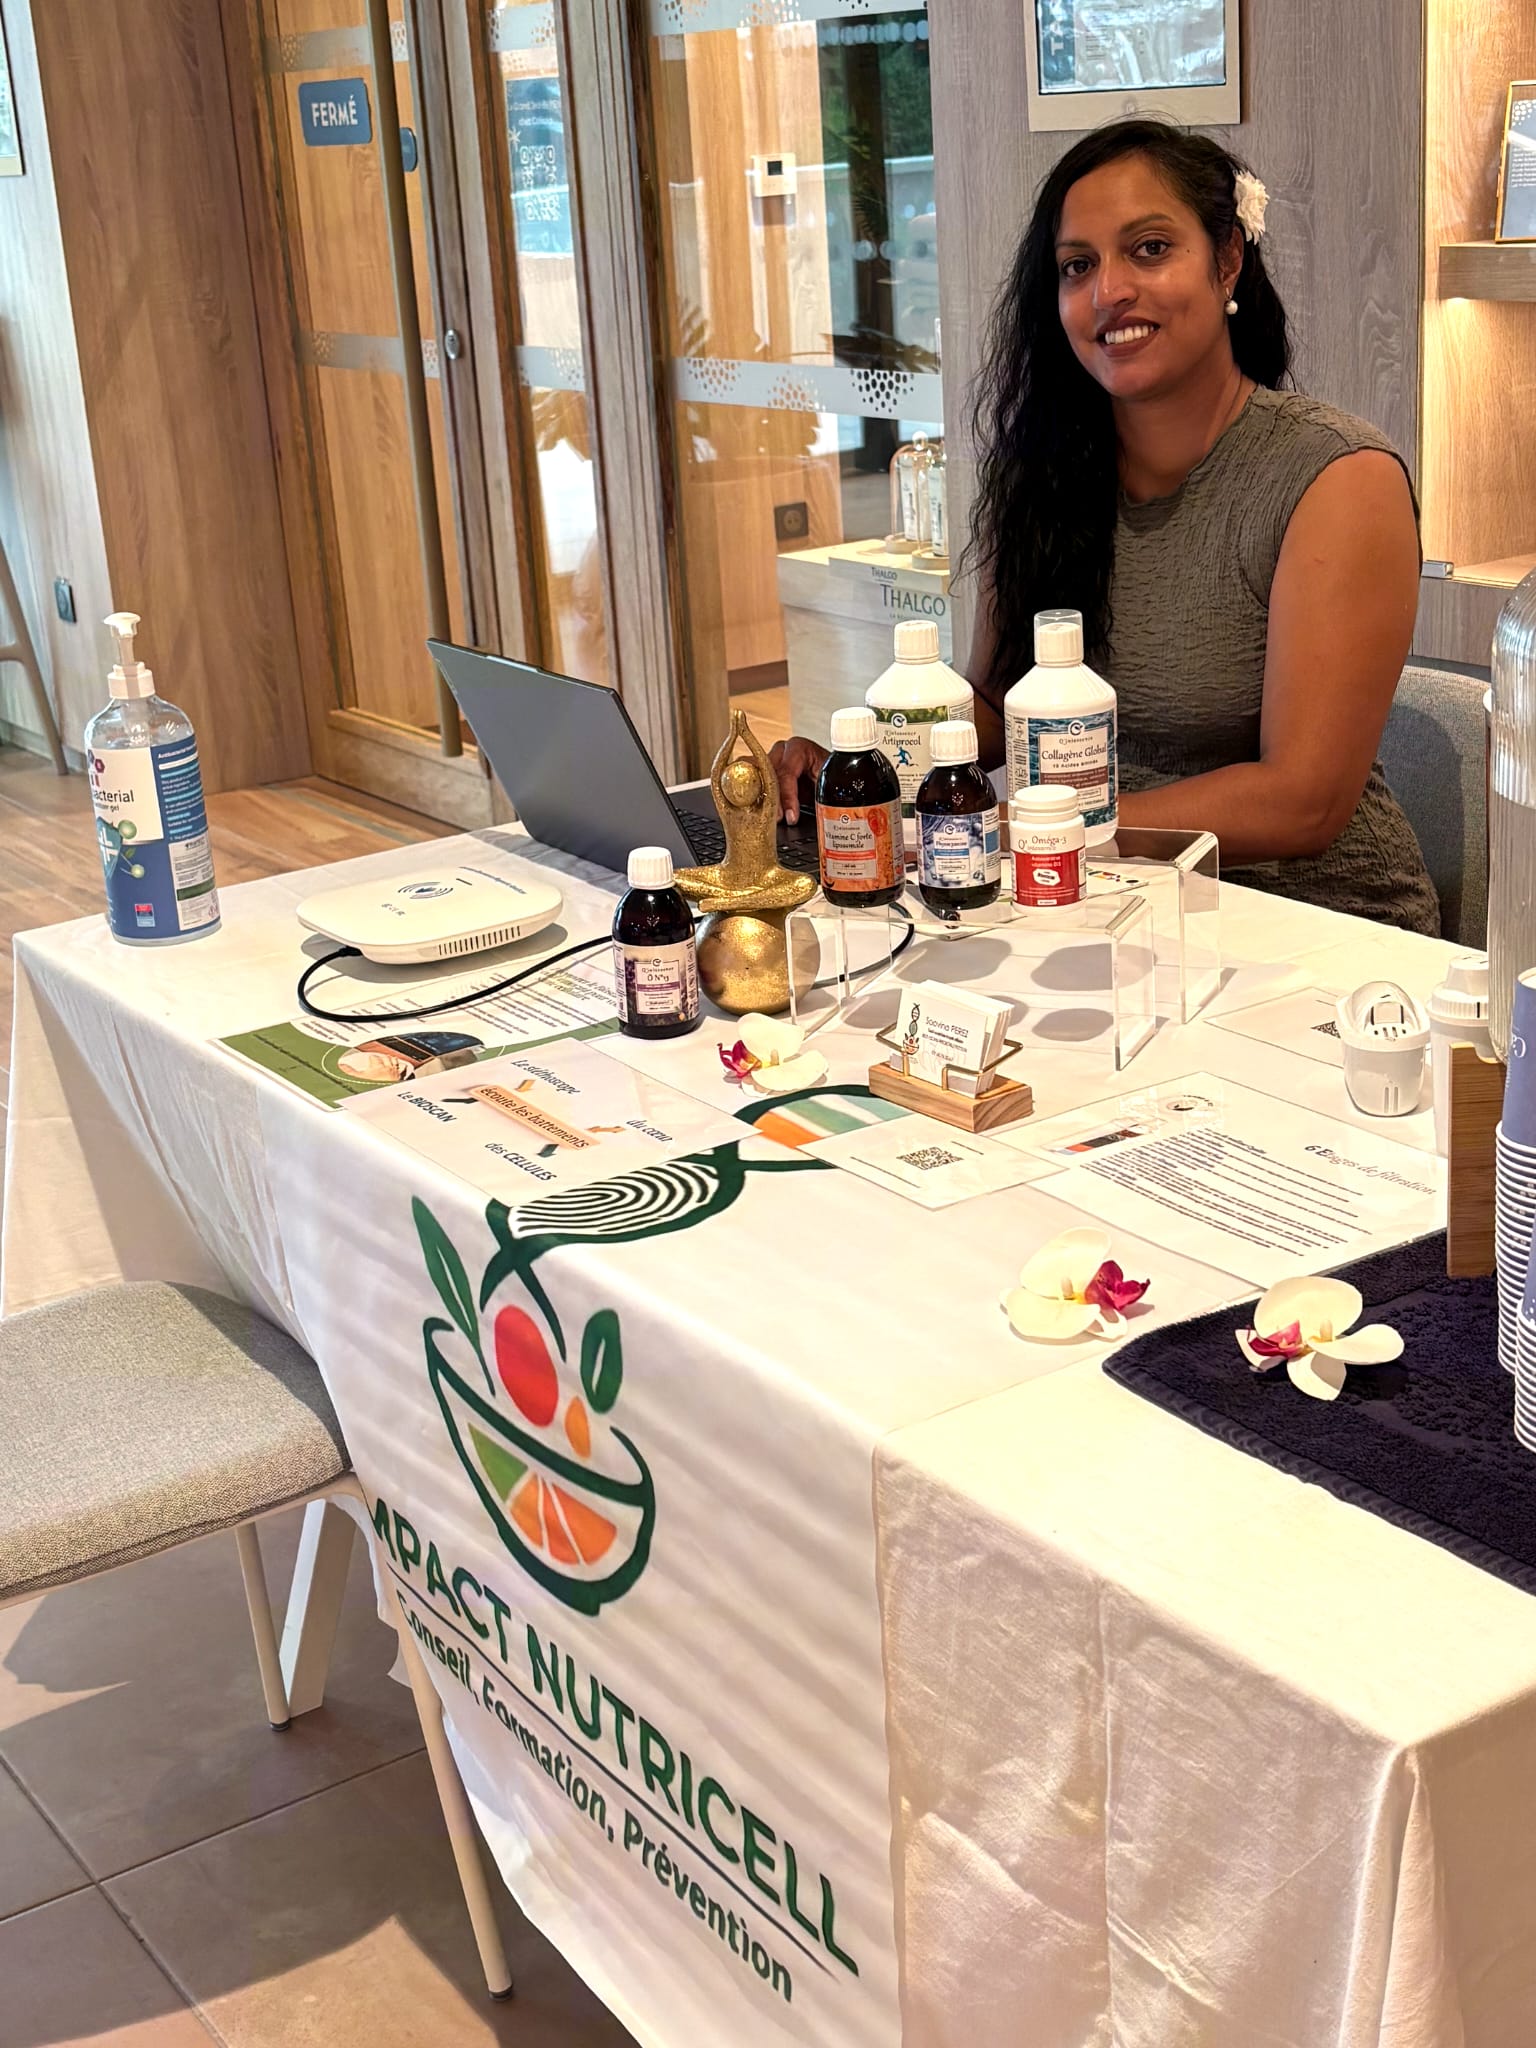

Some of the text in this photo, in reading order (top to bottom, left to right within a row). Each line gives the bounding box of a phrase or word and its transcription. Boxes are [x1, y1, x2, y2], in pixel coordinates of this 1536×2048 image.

[311, 94, 358, 128] FERMÉ
[871, 567, 897, 580] THALGO
[880, 584, 946, 616] THALGO
[1041, 743, 1107, 762] Collagène Global
[510, 1059, 527, 1069] Le
[397, 1091, 457, 1122] Le BIOSCAN
[480, 1087, 590, 1149] écoute les battements
[626, 1119, 648, 1131] du
[484, 1142, 558, 1181] des CELLULES
[1357, 1165, 1378, 1174] de
[1366, 1171, 1437, 1195] filtration
[396, 1589, 792, 2003] Conseil, Formation, Prévention
[526, 1623, 859, 1977] NUTRICELL
